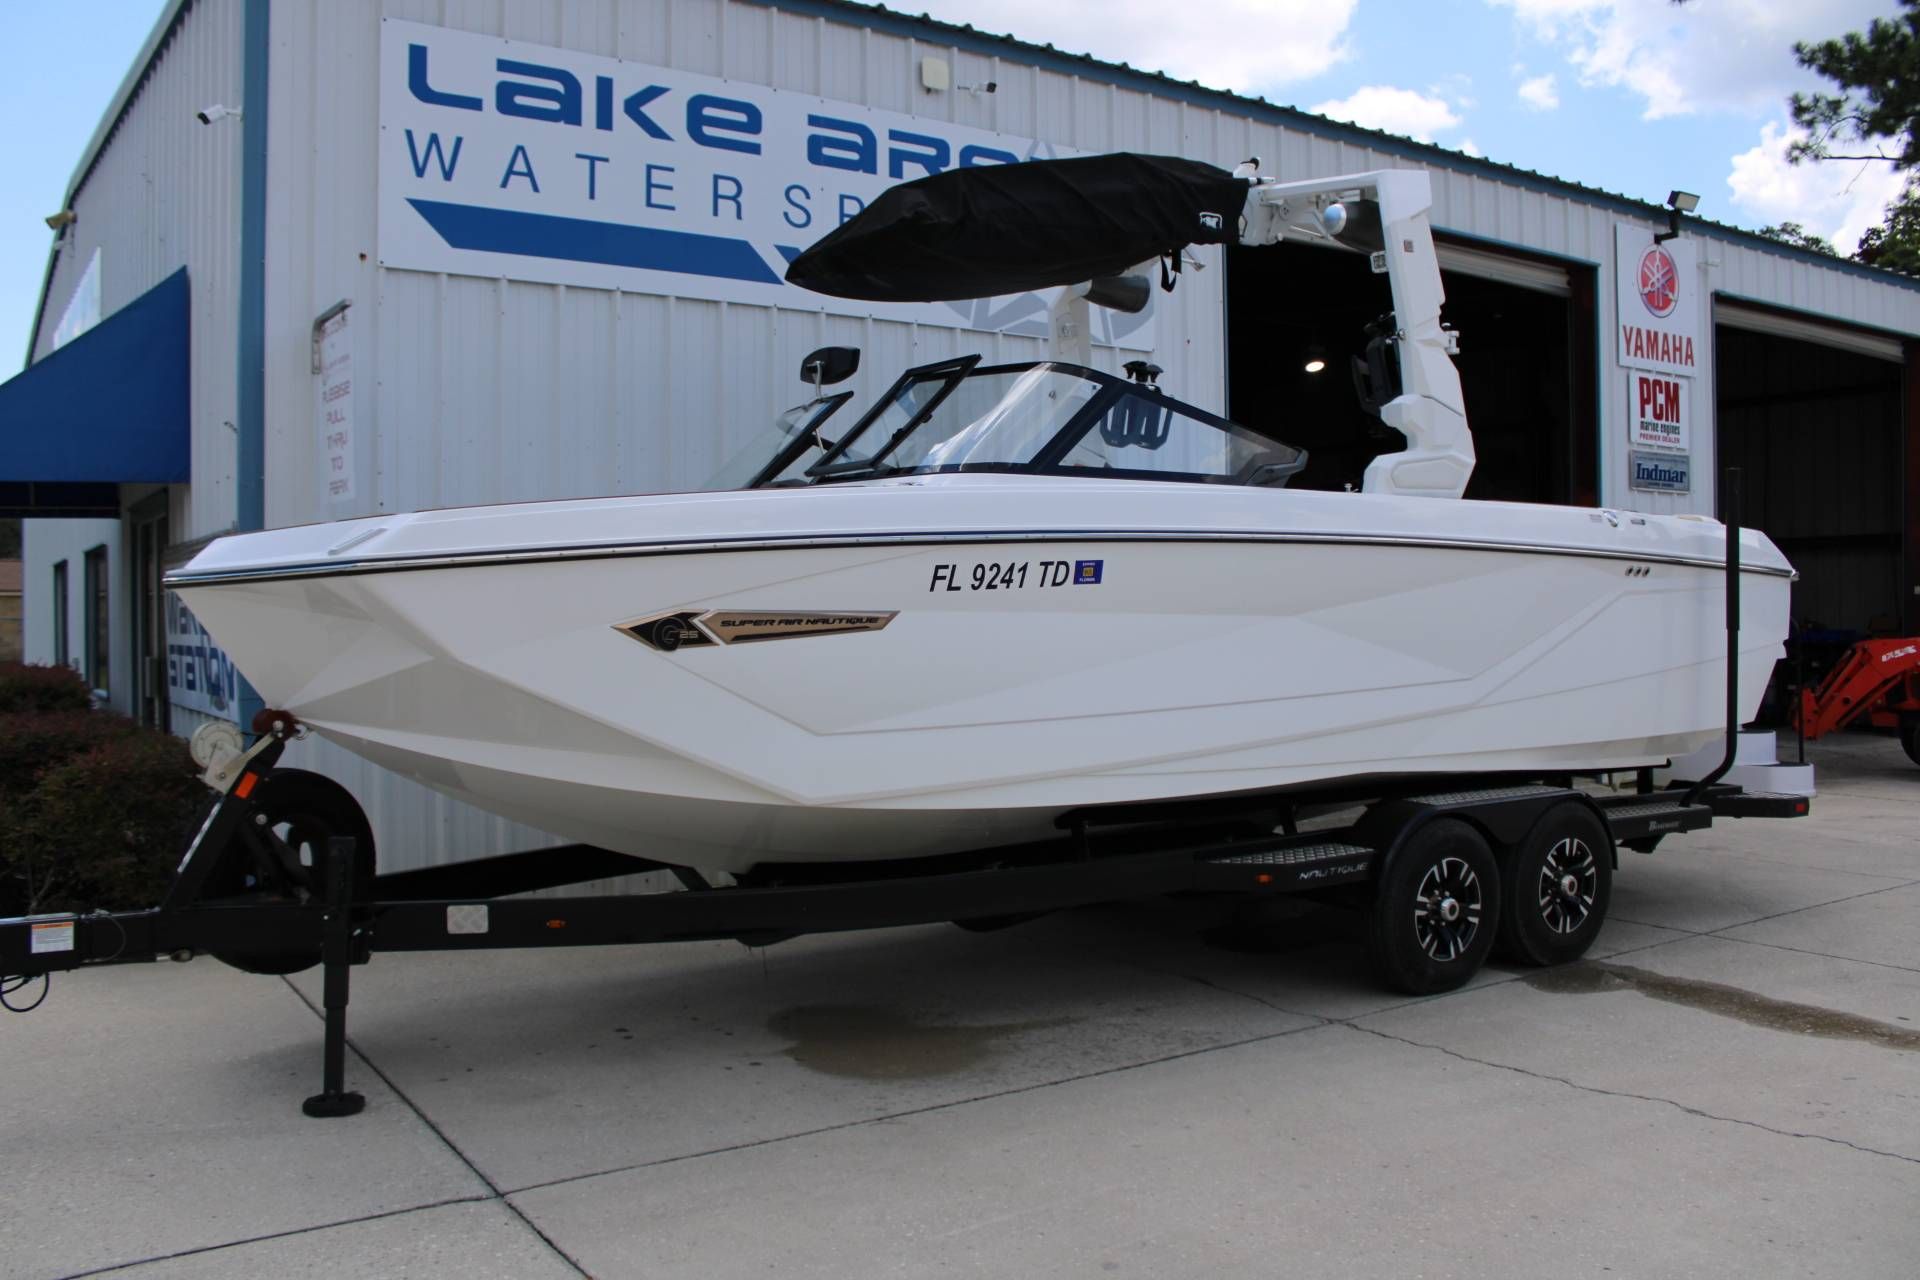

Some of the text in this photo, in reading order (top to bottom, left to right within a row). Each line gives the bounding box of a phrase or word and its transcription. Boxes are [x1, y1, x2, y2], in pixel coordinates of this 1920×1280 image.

[407, 42, 762, 156] Lake
[1622, 324, 1695, 368] YAMAHA
[1638, 376, 1680, 424] PCM
[1636, 463, 1687, 484] Indmar
[929, 560, 1071, 593] FL 9241 TD
[720, 616, 880, 627] SUPER AIR NAUTIQUE
